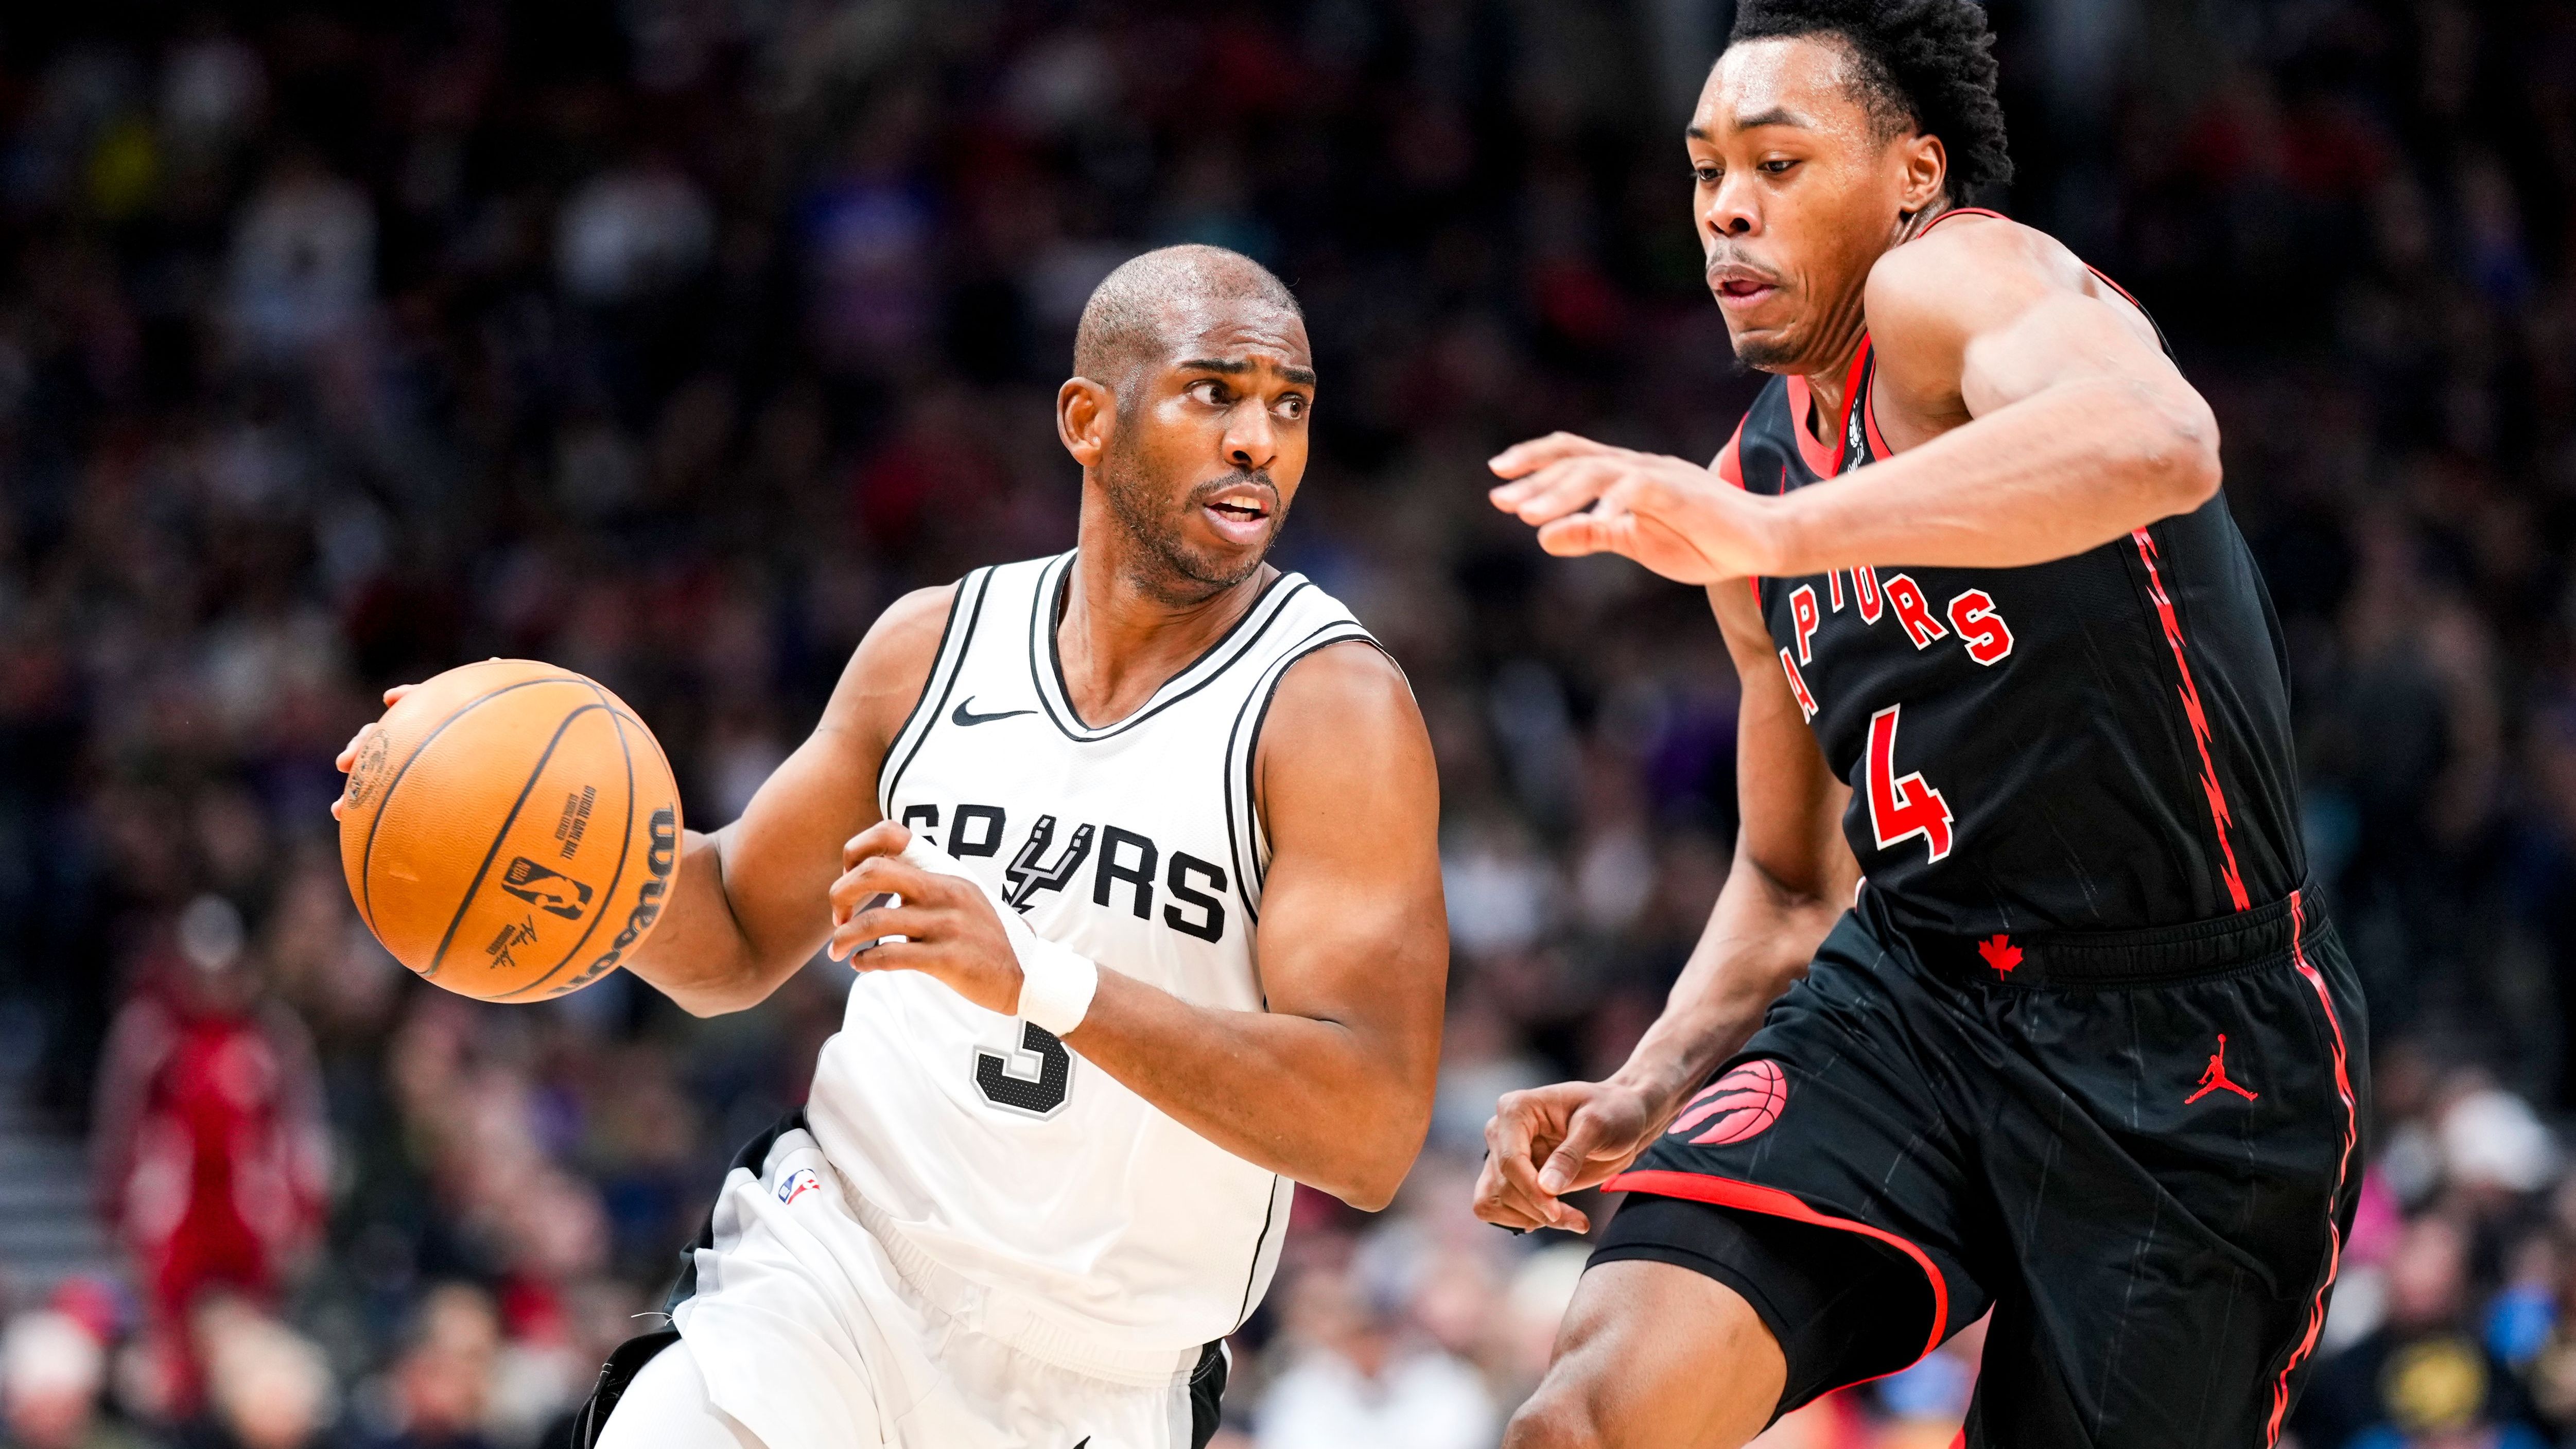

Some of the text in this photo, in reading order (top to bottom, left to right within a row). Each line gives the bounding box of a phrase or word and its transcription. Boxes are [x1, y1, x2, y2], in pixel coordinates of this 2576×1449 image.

[1866, 703, 1954, 865] 4
[510, 860, 531, 882] NBA
[969, 1017, 1078, 1123] 3
